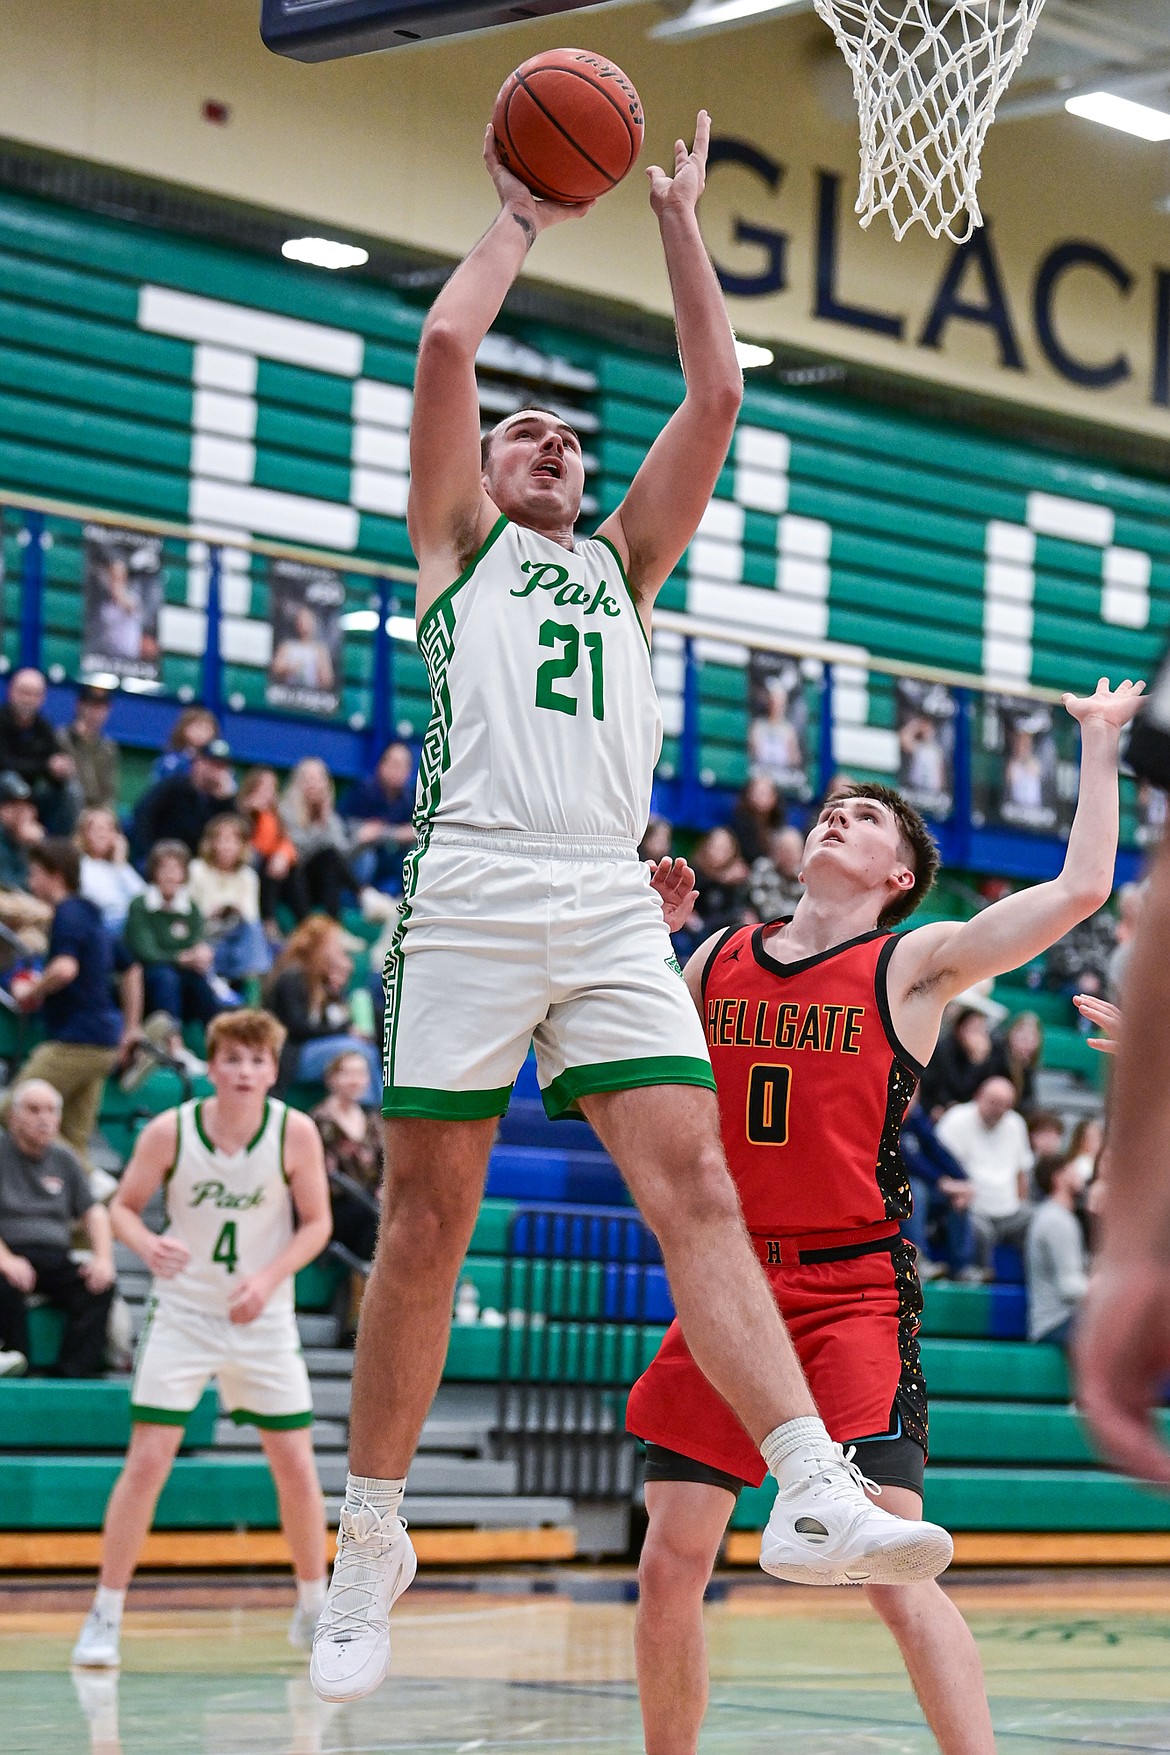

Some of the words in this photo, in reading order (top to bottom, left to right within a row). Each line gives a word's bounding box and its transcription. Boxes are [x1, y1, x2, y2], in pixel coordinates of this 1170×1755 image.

[535, 618, 605, 722] 21
[708, 998, 866, 1056] HELLGATE
[746, 1062, 793, 1147] 0
[212, 1220, 238, 1274] 4
[765, 1240, 783, 1265] H
